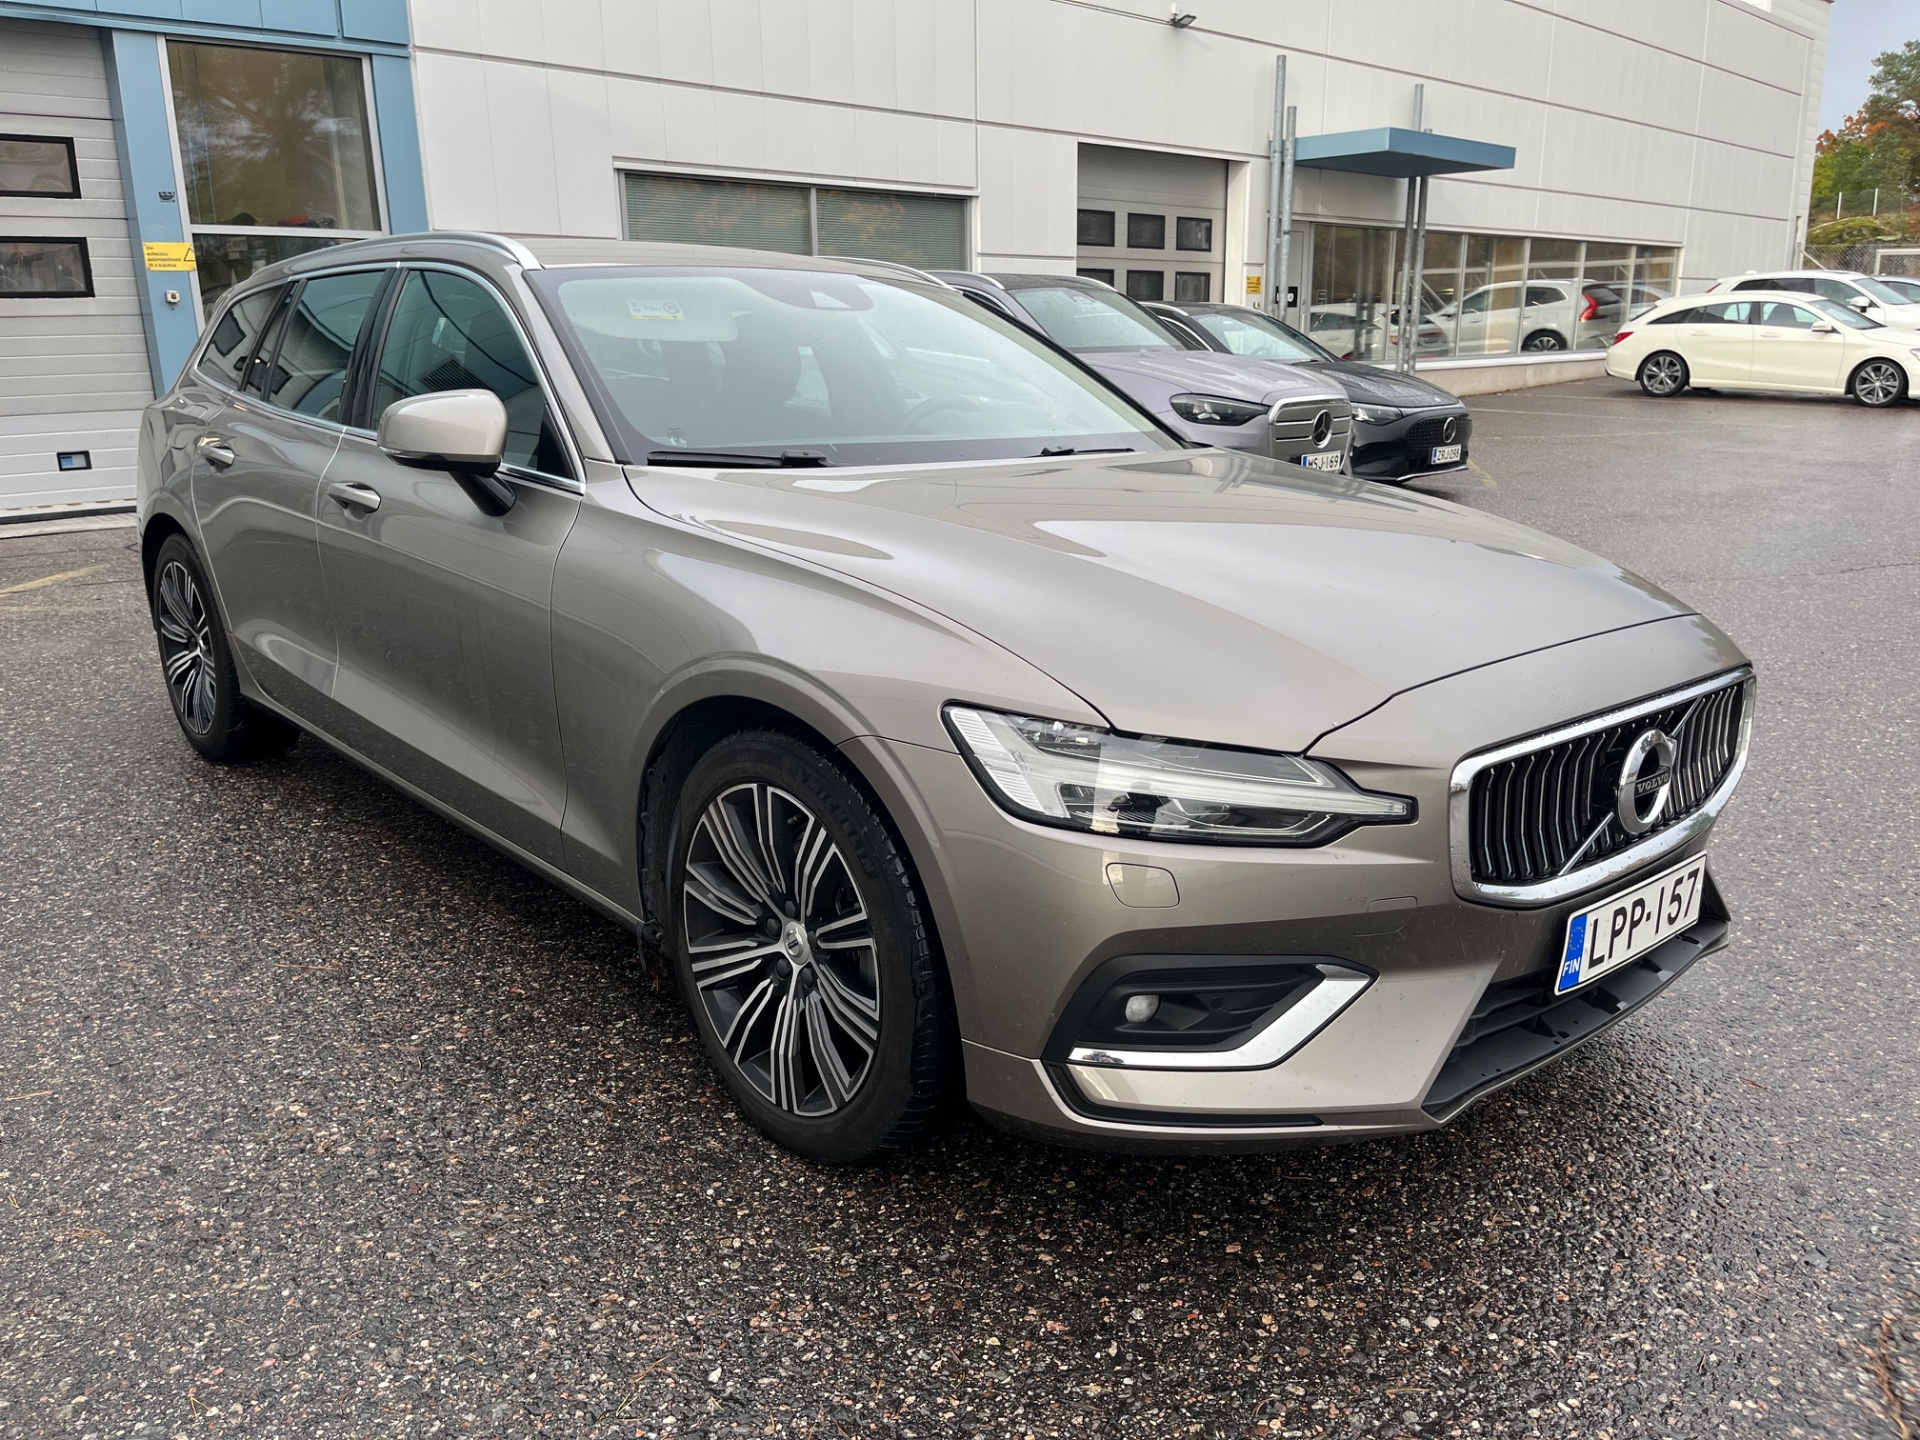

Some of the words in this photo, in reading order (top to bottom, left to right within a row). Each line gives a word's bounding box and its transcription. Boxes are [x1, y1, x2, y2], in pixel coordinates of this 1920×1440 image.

[1636, 773, 1669, 793] VOLVO
[1588, 867, 1700, 970] LPP-157
[1562, 956, 1581, 977] FIN
